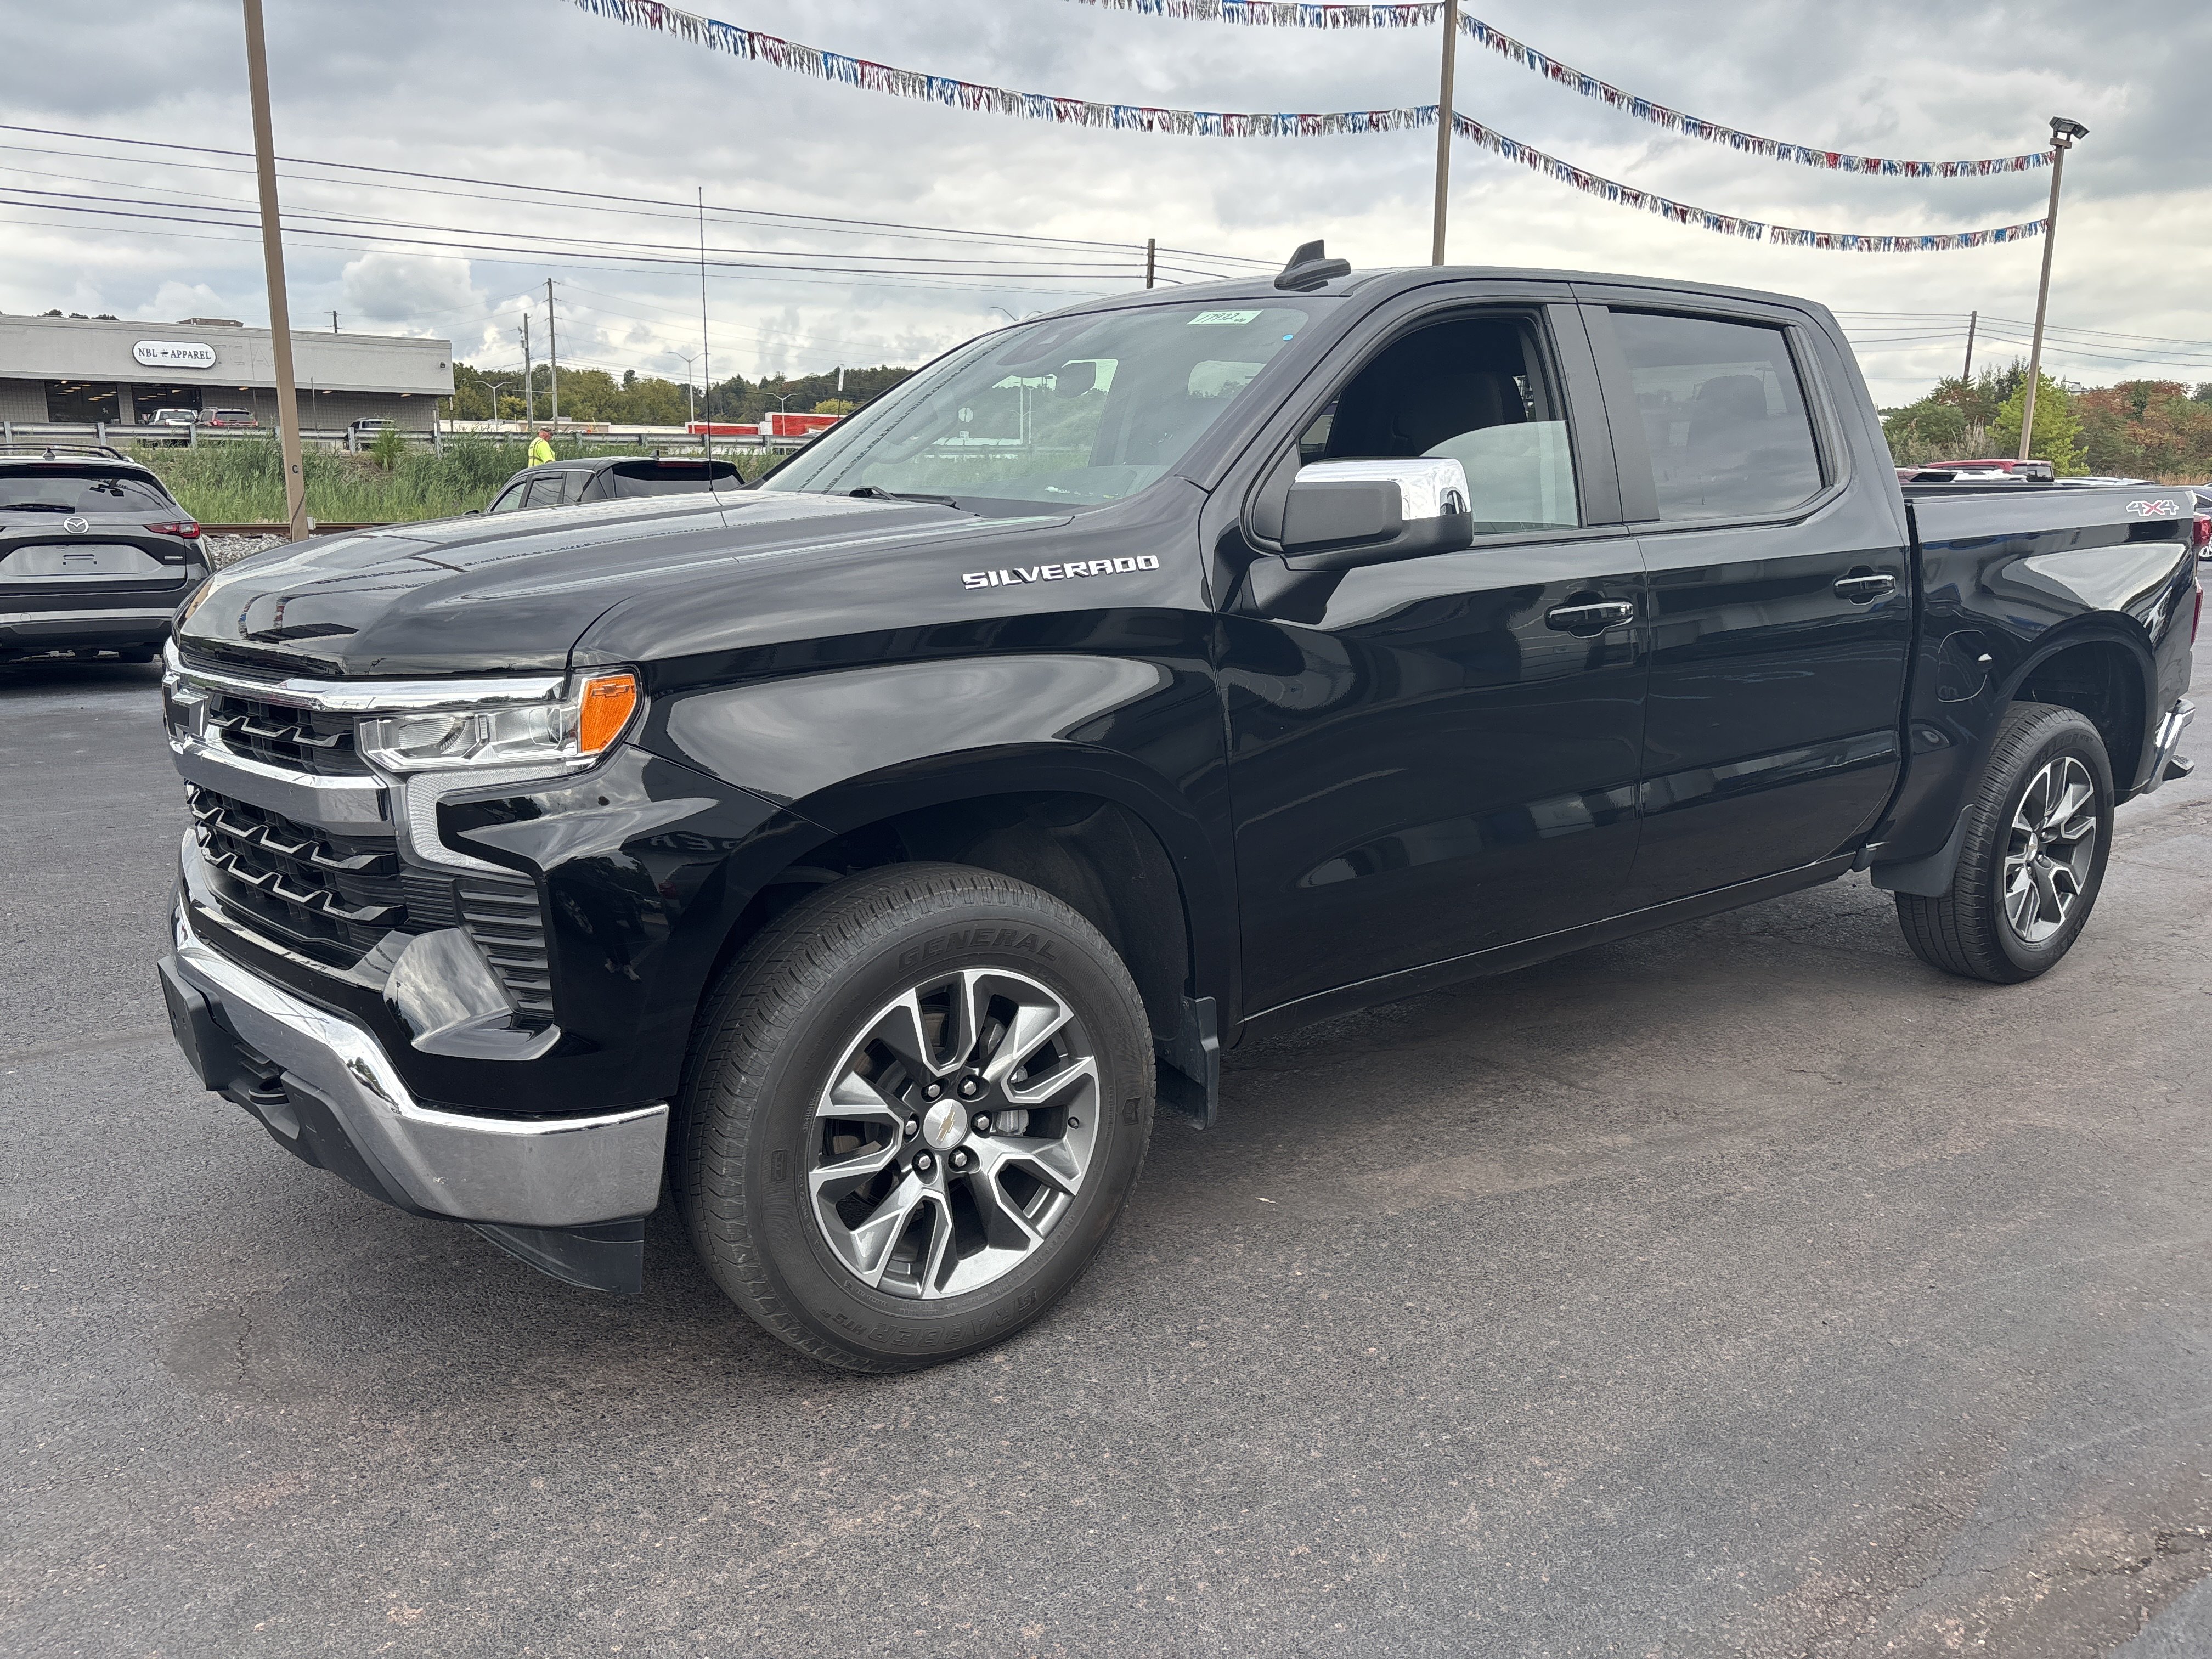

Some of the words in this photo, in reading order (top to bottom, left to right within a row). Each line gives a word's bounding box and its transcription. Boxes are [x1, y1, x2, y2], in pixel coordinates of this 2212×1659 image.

[138, 348, 158, 357] NBL
[170, 349, 211, 360] APPAREL
[961, 555, 1160, 590] SILVERADO
[898, 928, 1058, 973] GENERAL
[868, 1286, 1037, 1346] GRABBER
